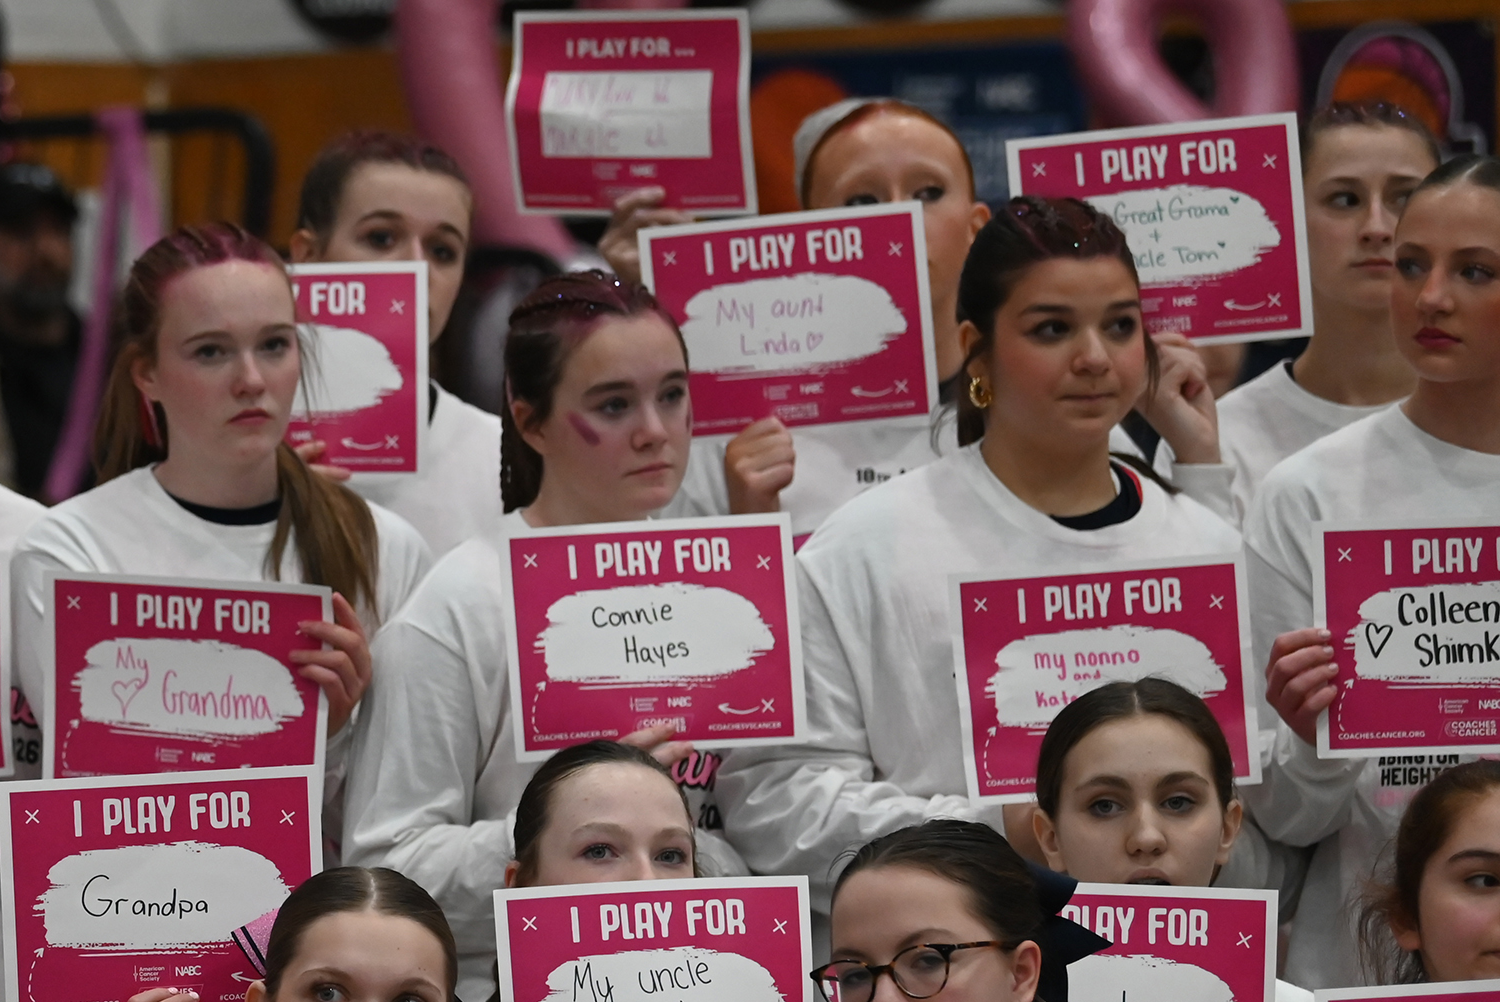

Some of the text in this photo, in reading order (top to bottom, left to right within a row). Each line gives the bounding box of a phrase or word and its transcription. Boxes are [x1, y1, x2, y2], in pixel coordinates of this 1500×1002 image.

[566, 39, 574, 58] I
[578, 38, 628, 58] PLAY
[1075, 138, 1238, 187] I PLAY FOR
[1113, 201, 1164, 227] Great
[704, 226, 864, 276] I PLAY FOR
[1172, 247, 1220, 266] Tom
[310, 281, 366, 317] FOR
[716, 294, 824, 330] My aunt
[568, 536, 732, 580] I PLAY FOR
[1384, 537, 1484, 576] I PLAY
[109, 591, 271, 636] I PLAY FOR
[592, 602, 674, 629] Connie
[1017, 577, 1182, 623] I PLAY FOR
[1397, 591, 1500, 627] Colleen
[115, 644, 150, 693] My
[623, 635, 690, 670] Hayes
[1074, 648, 1141, 668] nonno
[1073, 669, 1102, 681] and
[161, 668, 274, 723] Grandma
[1338, 732, 1426, 741] COACHES.CANCER.ORG
[1452, 719, 1497, 730] COACHES
[1458, 728, 1498, 738] CANCER
[73, 791, 251, 837] I PLAY FOR
[81, 874, 209, 920] Grandpa
[570, 898, 747, 944] I PLAY FOR
[1148, 907, 1209, 947] FOR
[138, 965, 166, 973] American
[175, 965, 202, 978] NABC
[638, 959, 712, 996] uncle
